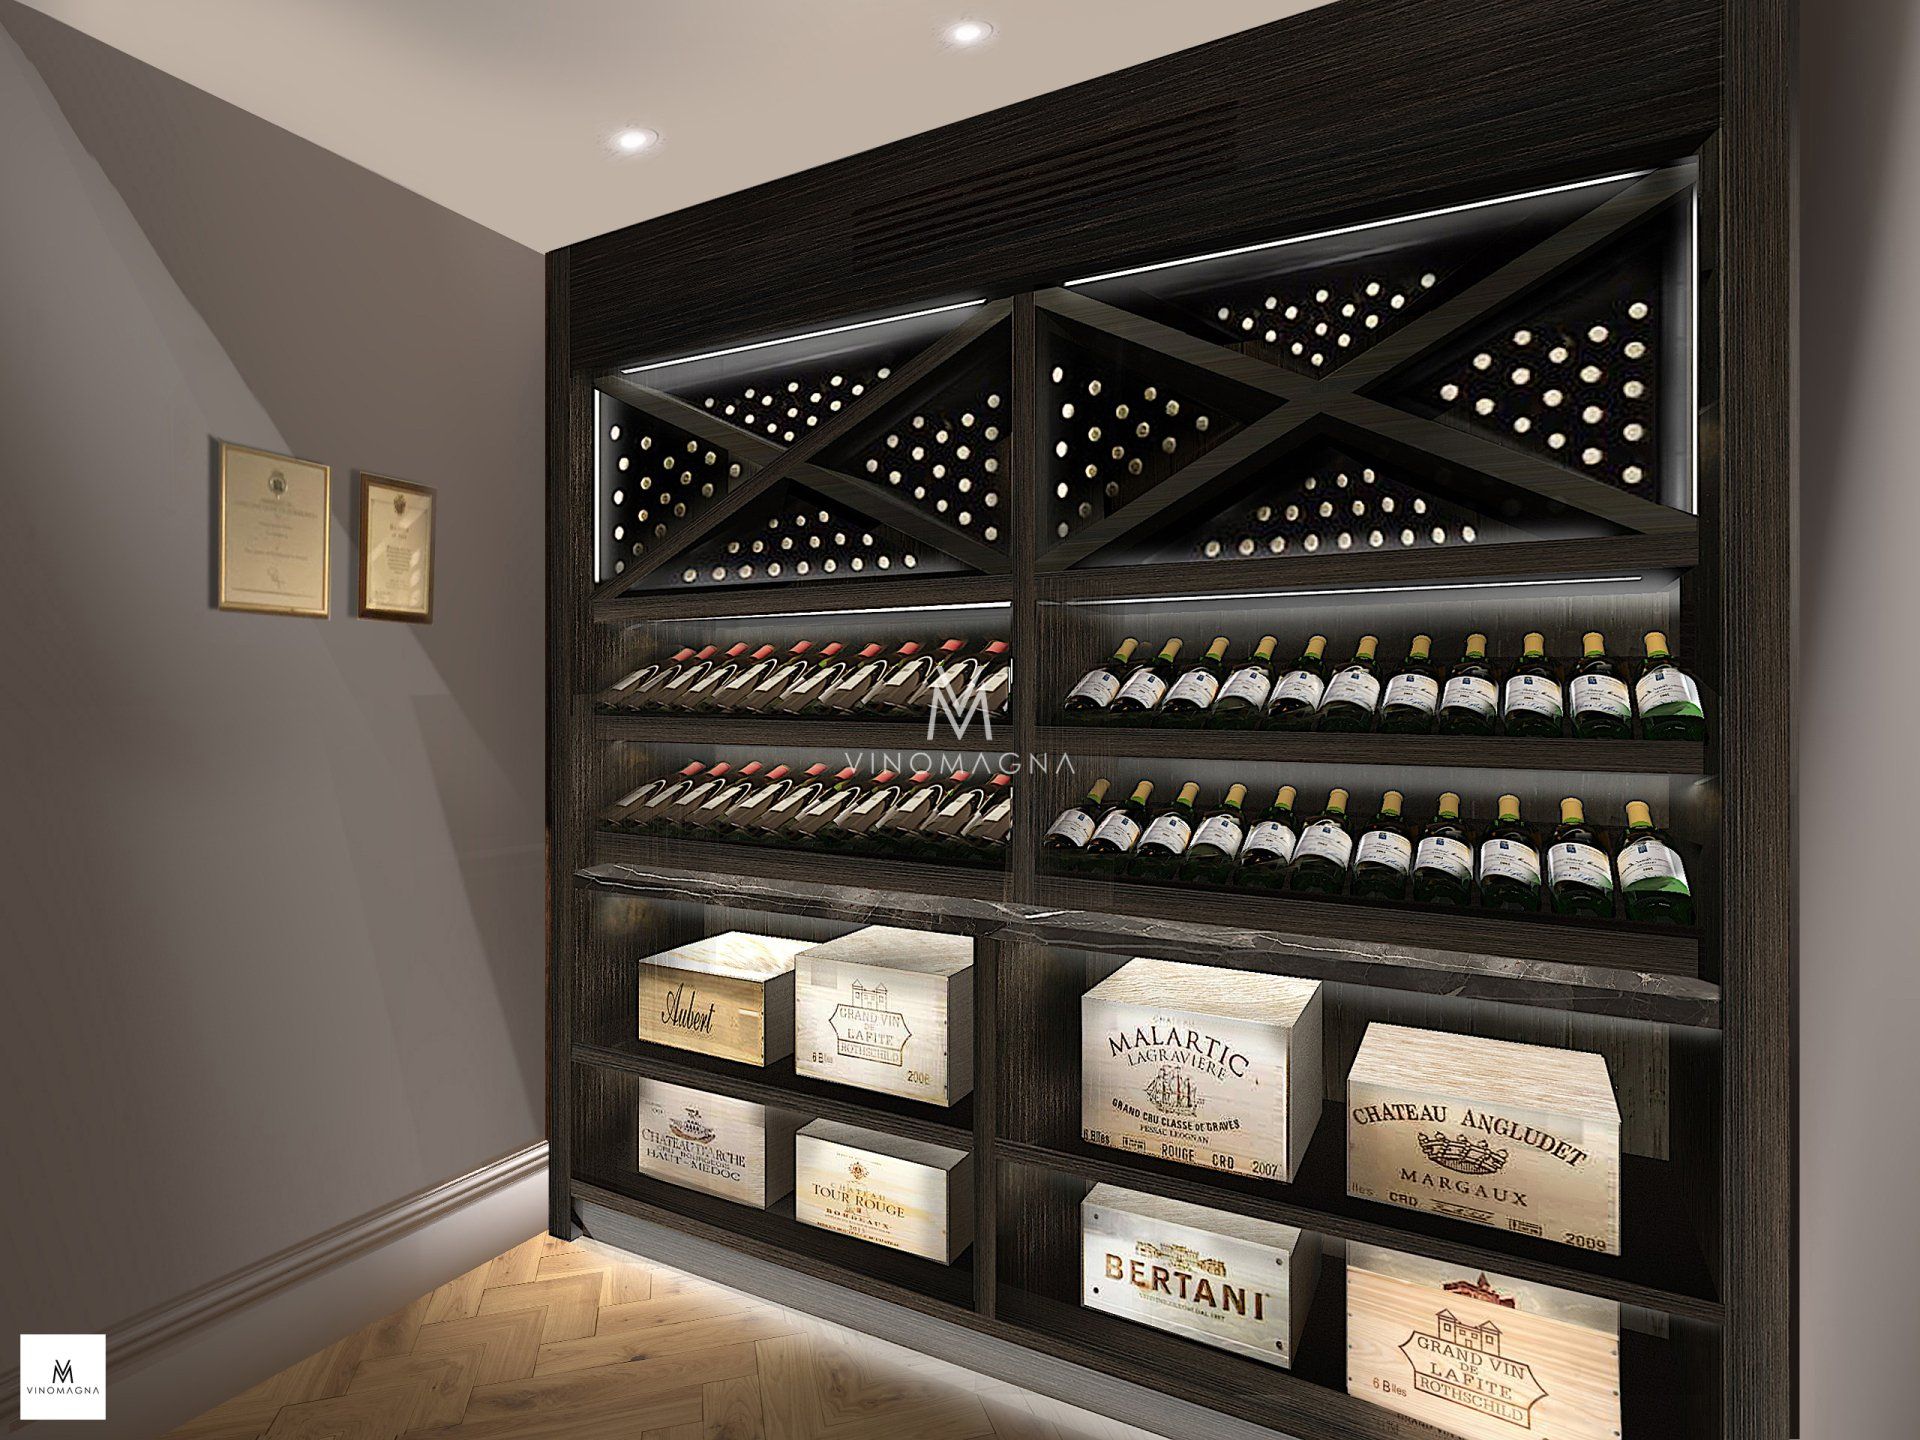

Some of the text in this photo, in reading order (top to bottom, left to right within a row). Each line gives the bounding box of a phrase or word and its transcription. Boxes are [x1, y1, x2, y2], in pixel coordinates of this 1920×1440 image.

[661, 982, 716, 1034] Aubert
[839, 1007, 901, 1028] GRAND VIN
[847, 1028, 894, 1047] LAFITE
[840, 1042, 900, 1062] ROTHSCHILD
[1108, 1025, 1250, 1078] MALARTIC
[1112, 1098, 1141, 1118] GRAND
[1142, 1110, 1160, 1124] CRU
[1161, 1115, 1193, 1131] CLASSE
[1205, 1118, 1241, 1133] GRAVES
[1140, 1123, 1168, 1137] PESSAC
[1353, 1102, 1588, 1168] CHATEAU ANGLUDET
[1161, 1143, 1196, 1162] ROUGE
[1211, 1153, 1235, 1169] CRD
[1252, 1161, 1278, 1177] 2007
[1389, 1191, 1418, 1207] CRD
[1401, 1168, 1529, 1208] MARGAUX
[812, 1183, 906, 1219] TOUR ROUGE
[826, 1207, 889, 1230] BORDEAUX
[1565, 1232, 1608, 1251] 2009
[1105, 1253, 1264, 1321] BERTANI
[1417, 1336, 1526, 1380] GRAND VIN
[1460, 1361, 1479, 1375] DE
[1372, 1377, 1380, 1389] 6
[1430, 1361, 1513, 1400] LAFITE
[1420, 1376, 1524, 1422] ROTHSCHILD
